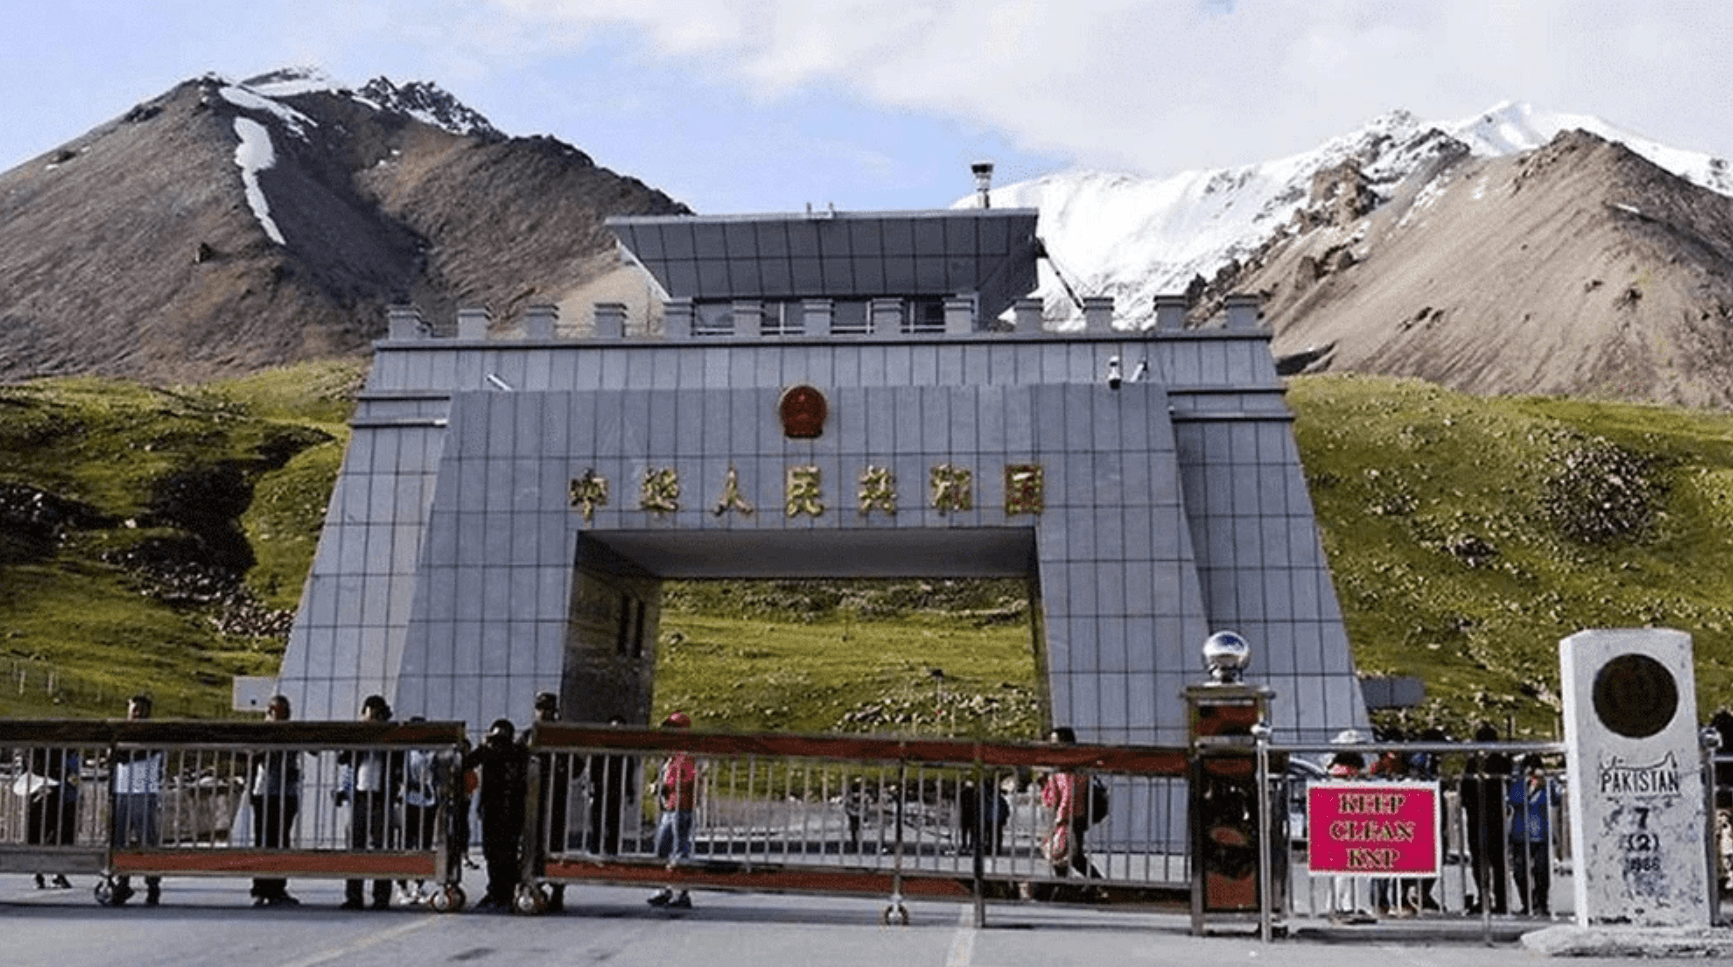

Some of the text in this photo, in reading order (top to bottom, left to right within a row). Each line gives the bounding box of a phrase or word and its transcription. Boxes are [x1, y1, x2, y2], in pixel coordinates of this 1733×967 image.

[1601, 770, 1679, 793] PAKISTAN
[1338, 793, 1406, 814] KEEP
[1634, 807, 1650, 829] 7
[1329, 820, 1416, 843] CLEAN
[1345, 848, 1400, 869] KNP
